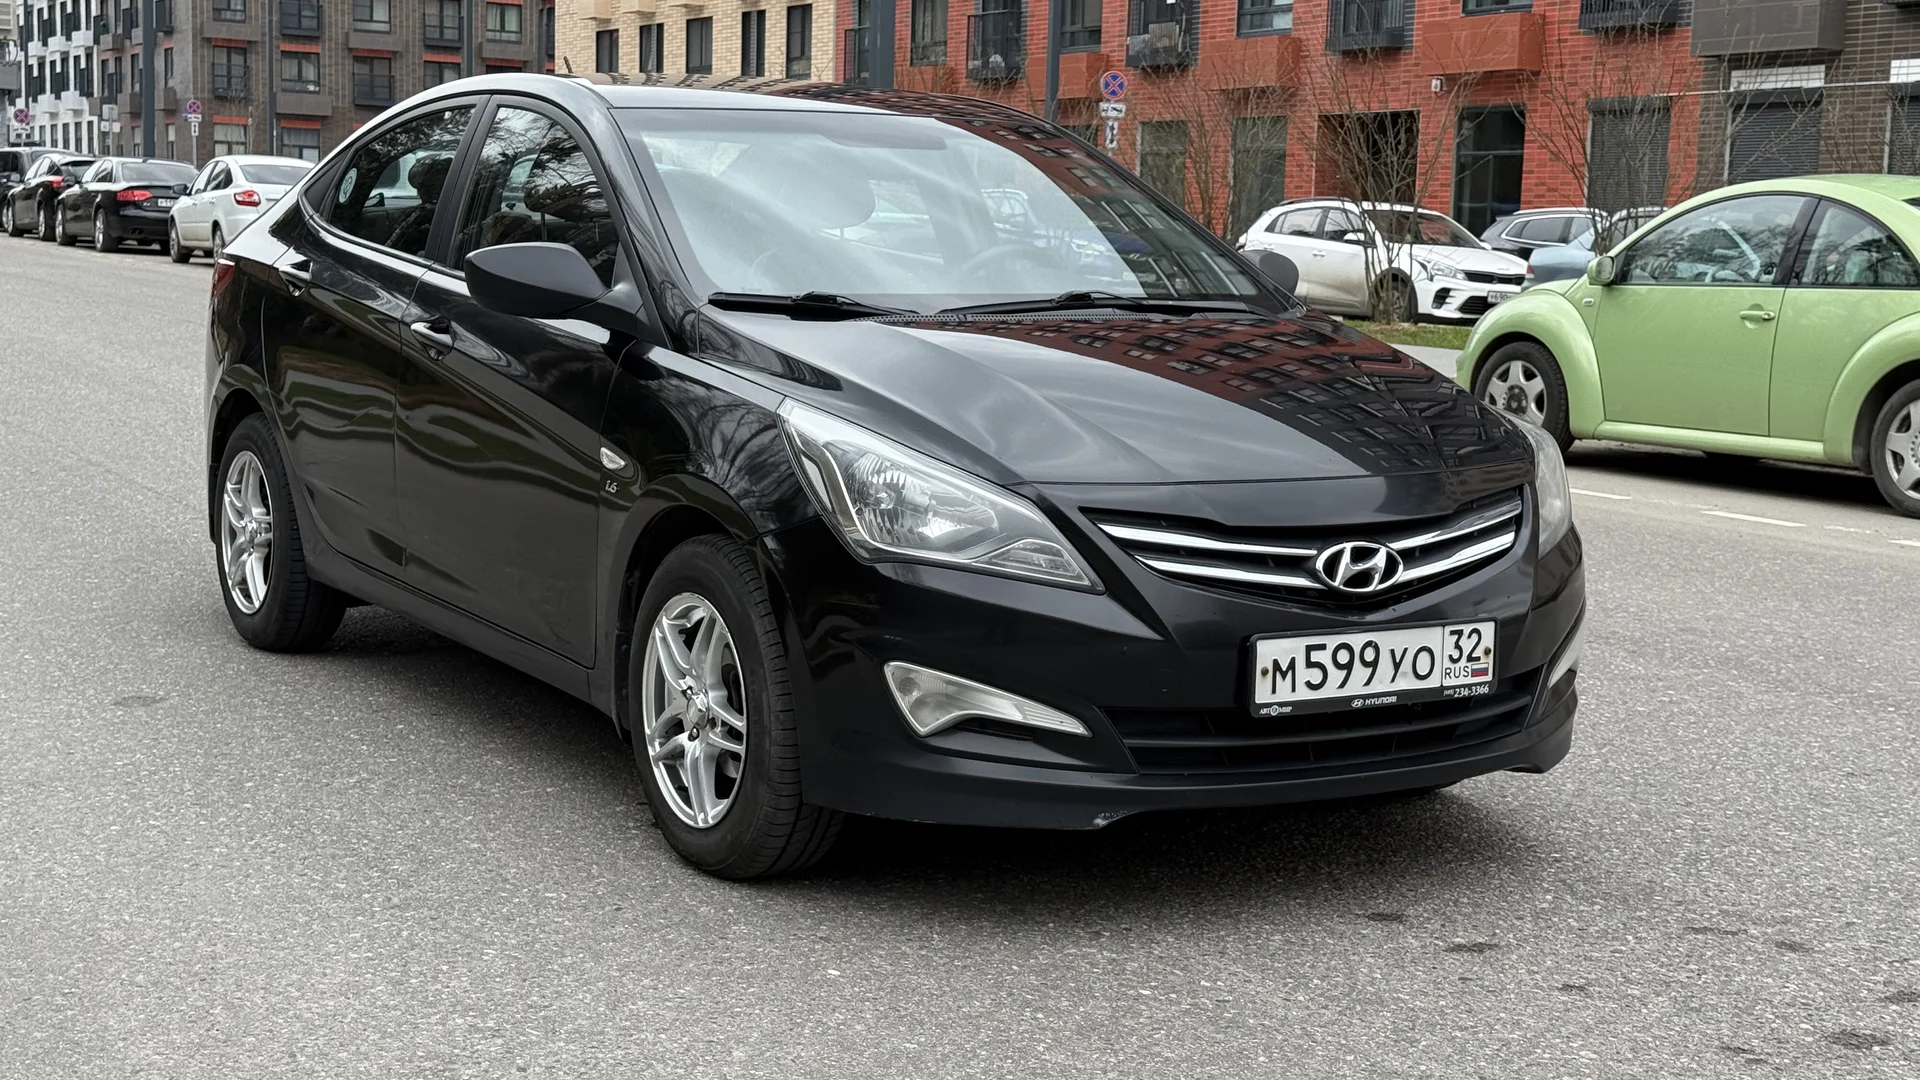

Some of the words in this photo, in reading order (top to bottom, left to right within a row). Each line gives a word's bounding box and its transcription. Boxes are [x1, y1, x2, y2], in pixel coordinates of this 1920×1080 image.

[1448, 627, 1482, 664] 32
[1444, 665, 1470, 680] RUS
[1454, 684, 1490, 698] 234-3366
[1365, 696, 1397, 706] HYUNDAI
